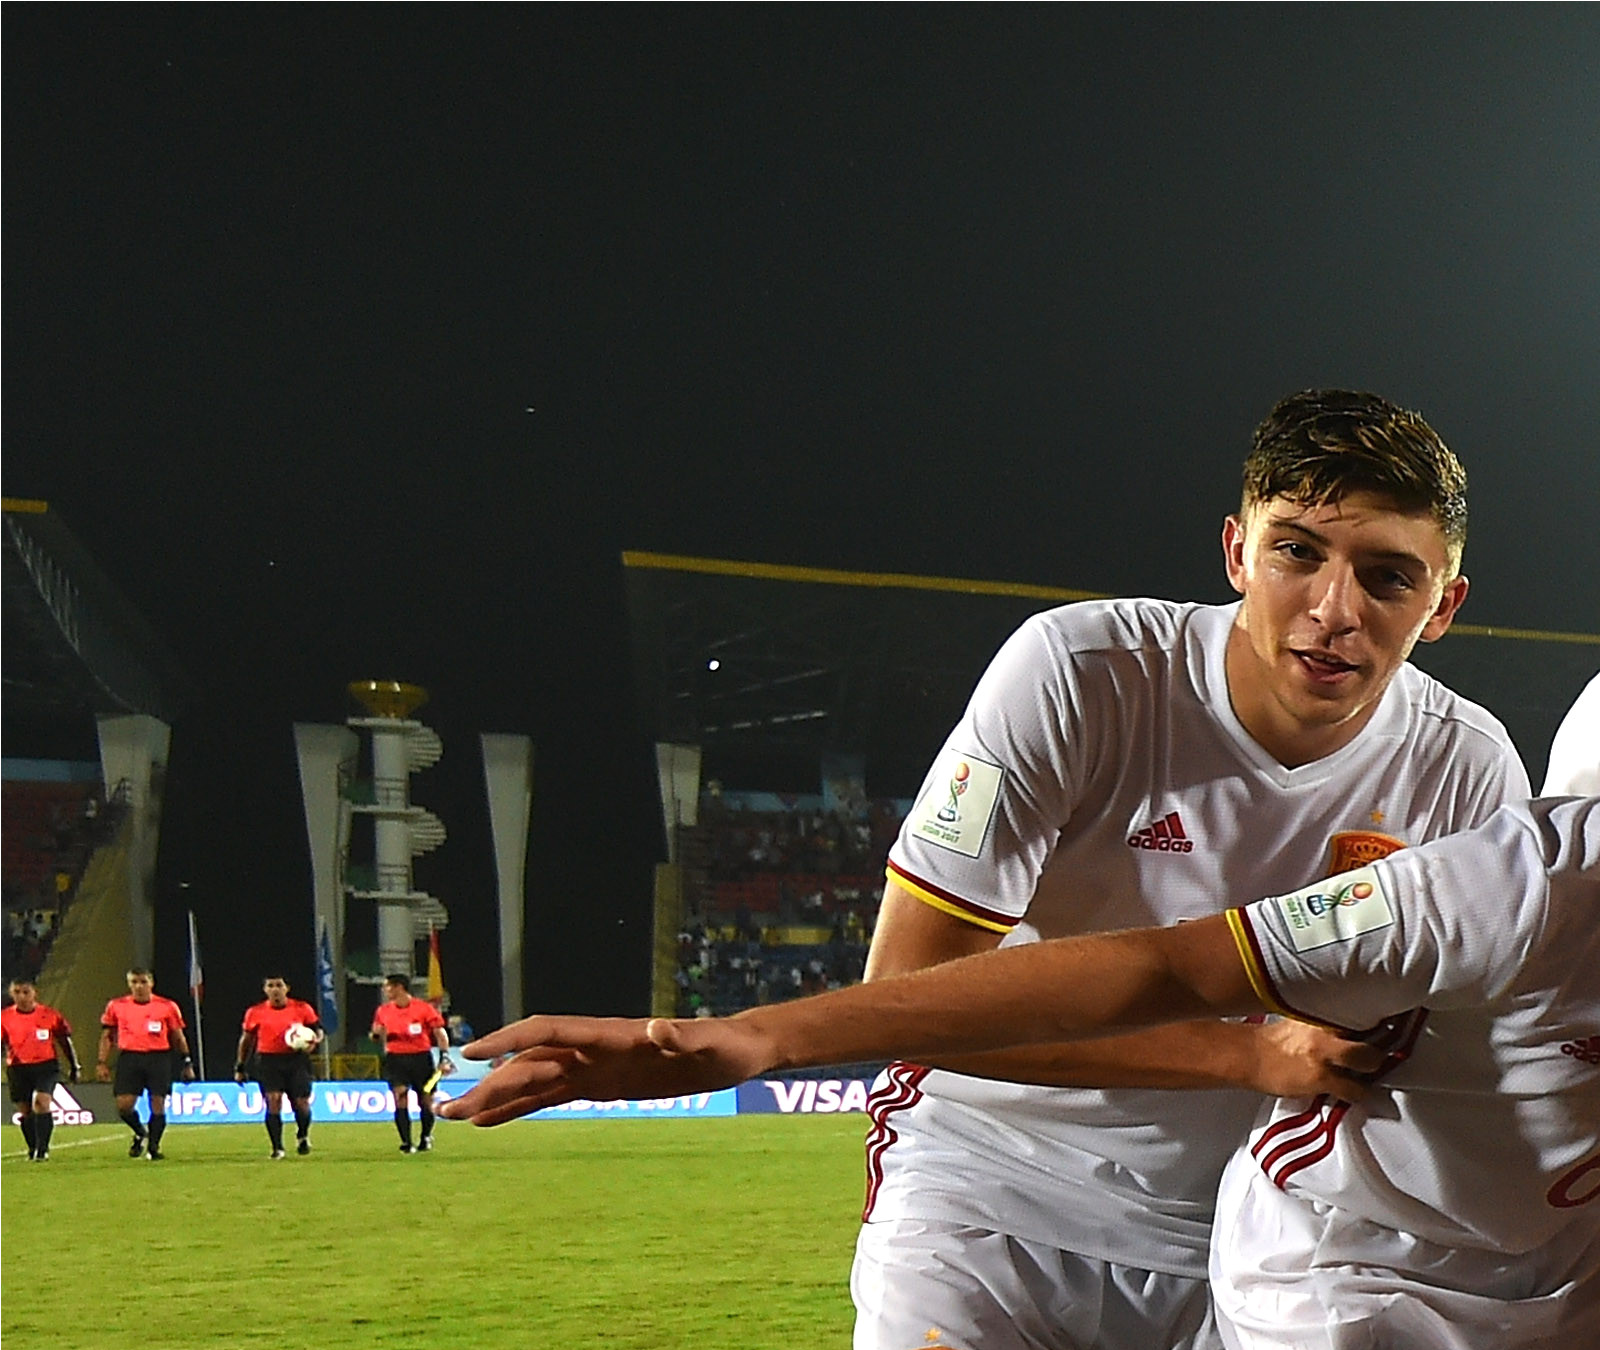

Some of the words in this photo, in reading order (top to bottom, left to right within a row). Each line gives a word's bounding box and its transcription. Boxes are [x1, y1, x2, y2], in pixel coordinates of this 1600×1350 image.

[1127, 834, 1194, 853] adidas
[764, 1079, 869, 1113] VISA
[12, 1109, 94, 1125] adas
